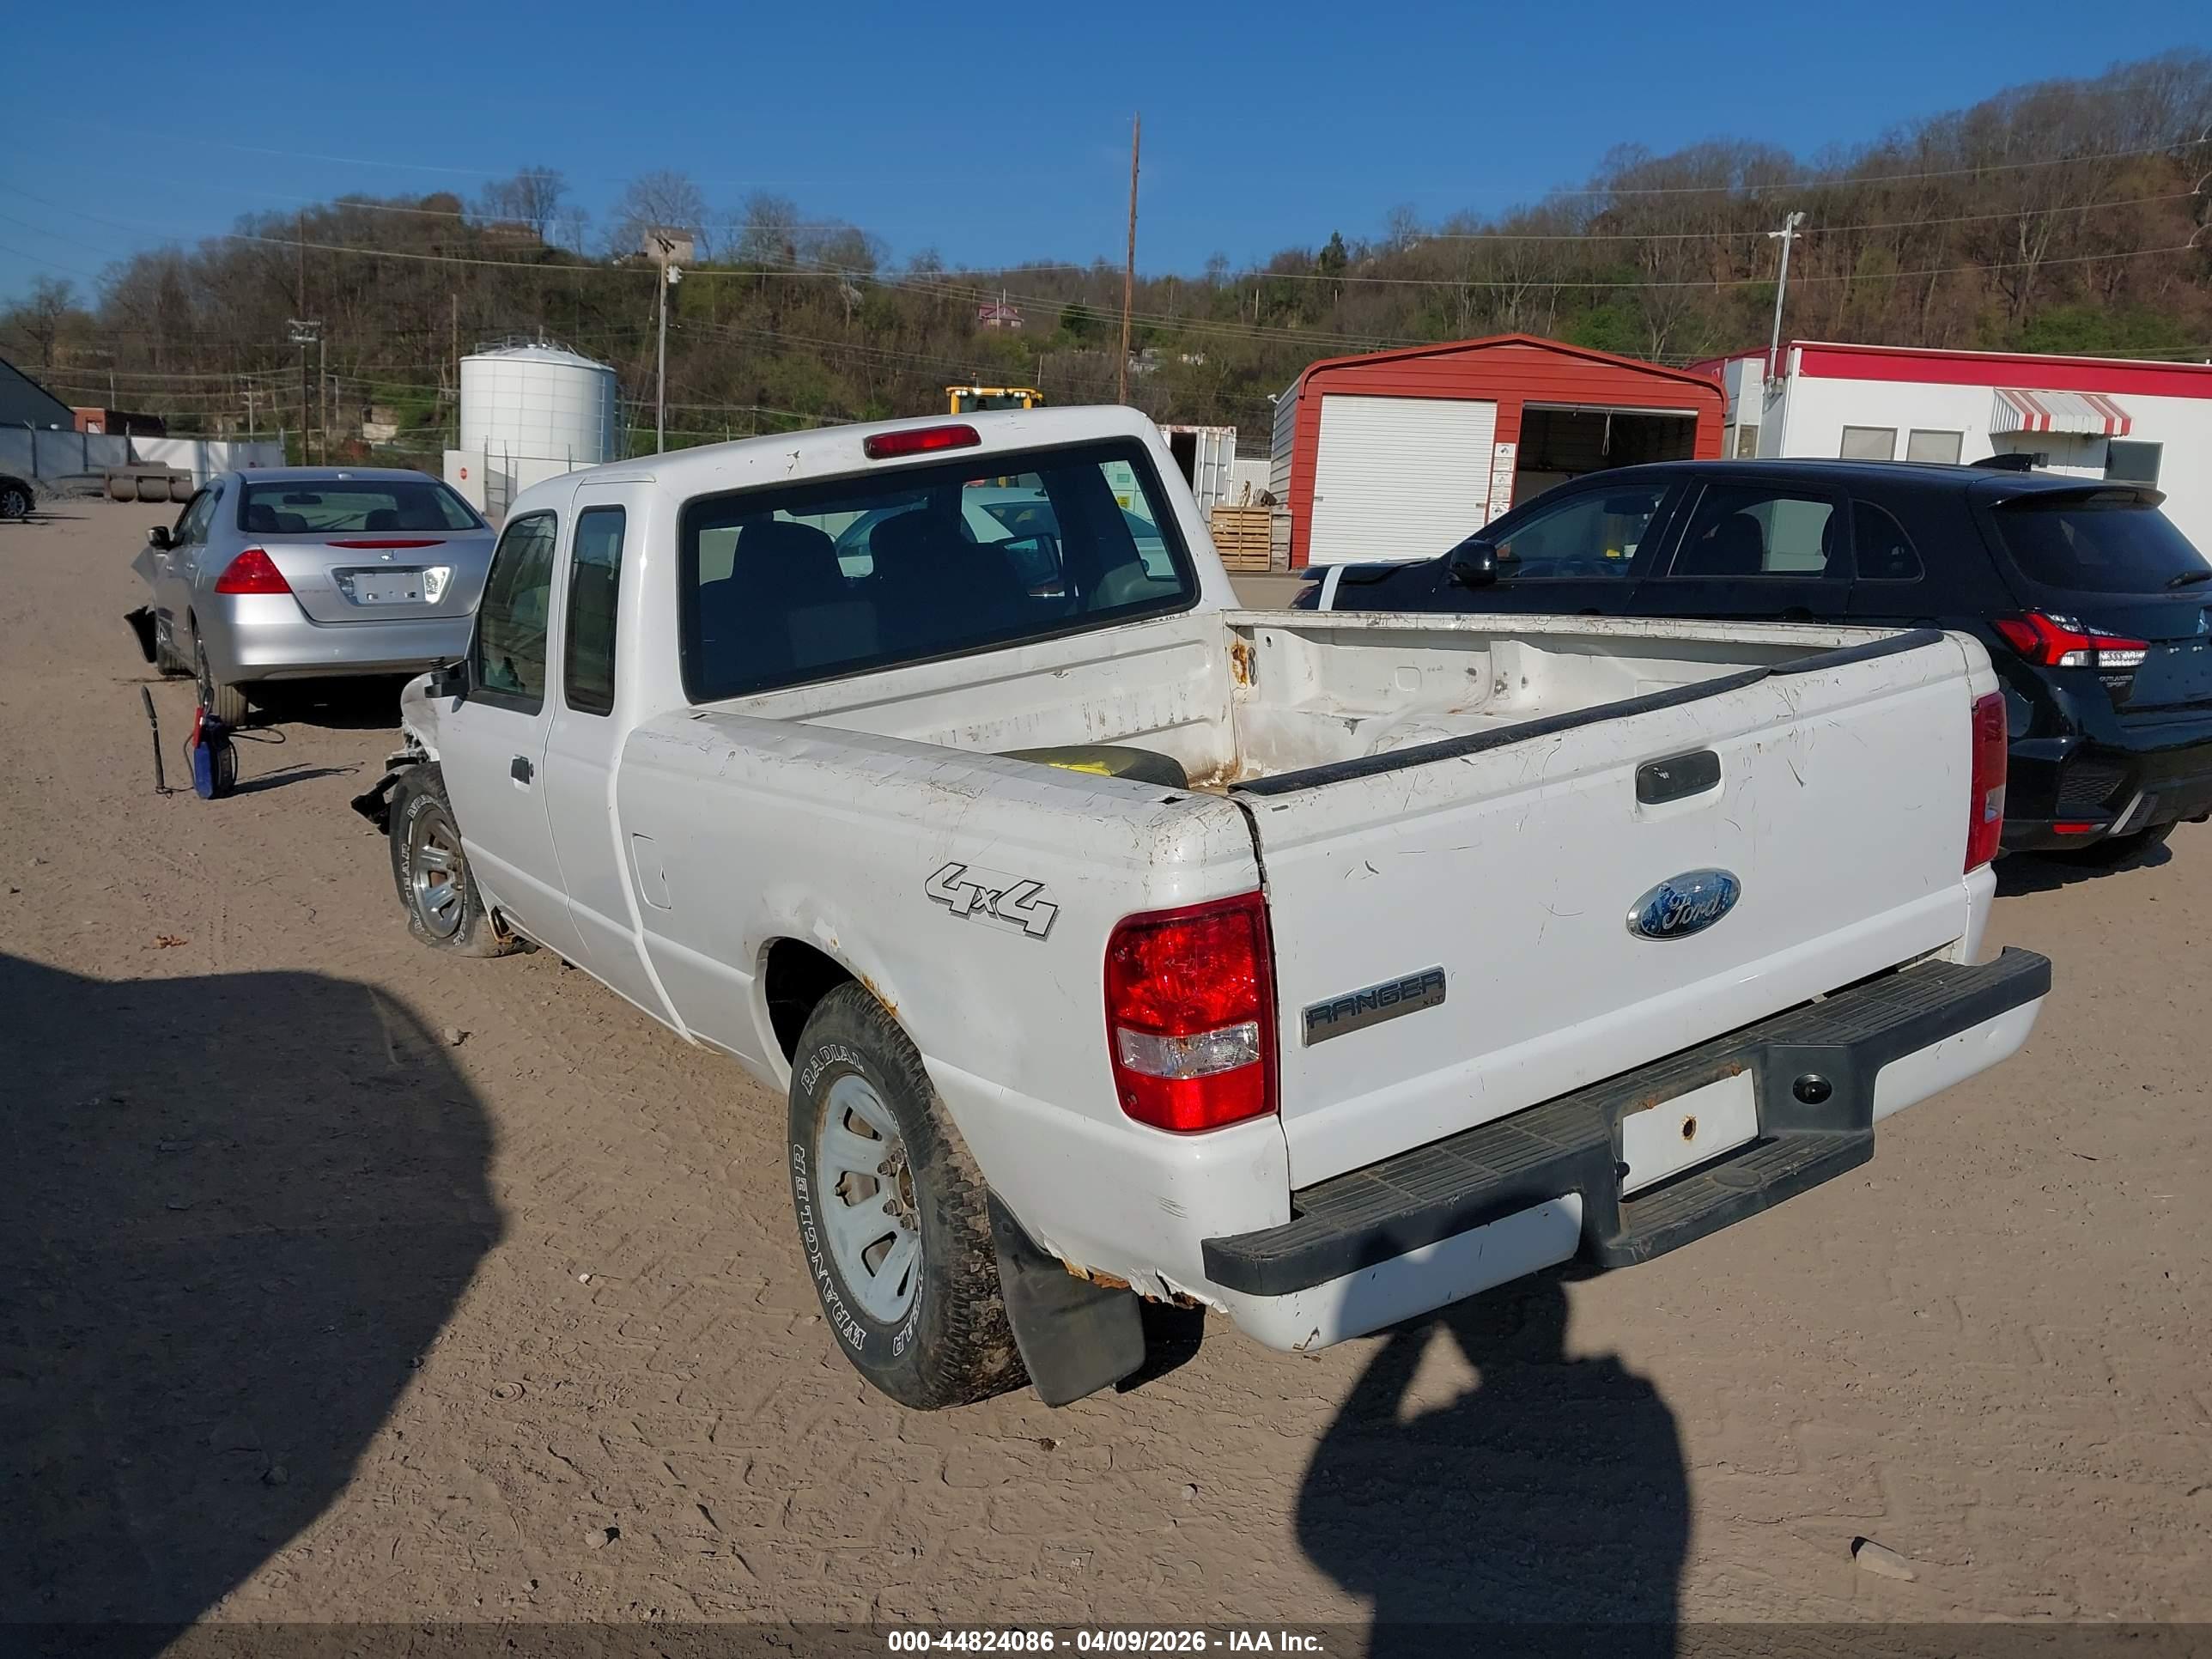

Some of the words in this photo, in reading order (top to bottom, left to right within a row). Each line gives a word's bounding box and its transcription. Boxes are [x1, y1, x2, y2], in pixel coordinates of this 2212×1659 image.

[1661, 889, 1723, 931] Ford
[1305, 969, 1444, 1030] RANGER
[1421, 994, 1443, 1007] XLT
[800, 1043, 866, 1097] RADIAL
[793, 1144, 867, 1352] WRANGLER
